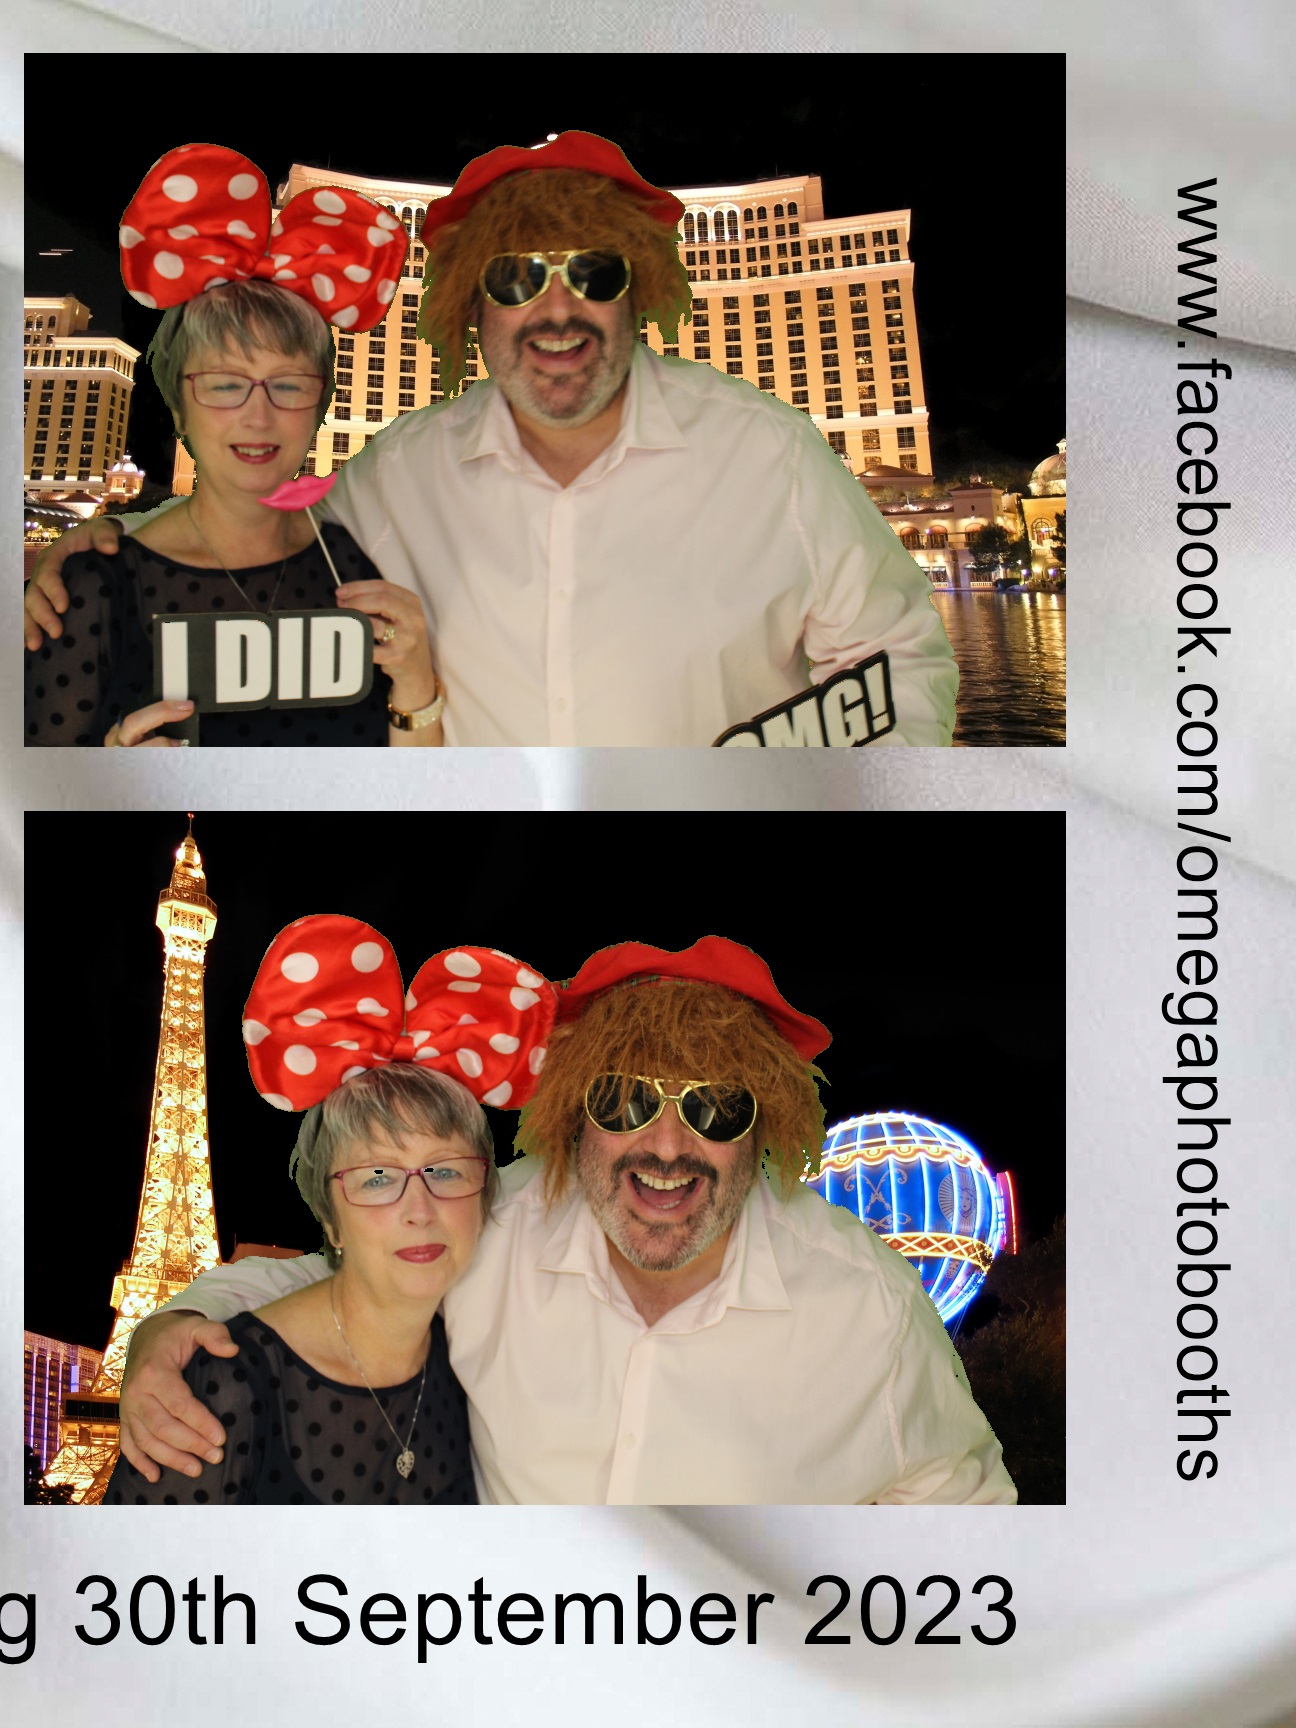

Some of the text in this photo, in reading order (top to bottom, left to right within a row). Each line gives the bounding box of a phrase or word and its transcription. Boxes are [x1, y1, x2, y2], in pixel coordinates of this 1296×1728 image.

[161, 616, 364, 703] I DID
[720, 662, 890, 747] MG!
